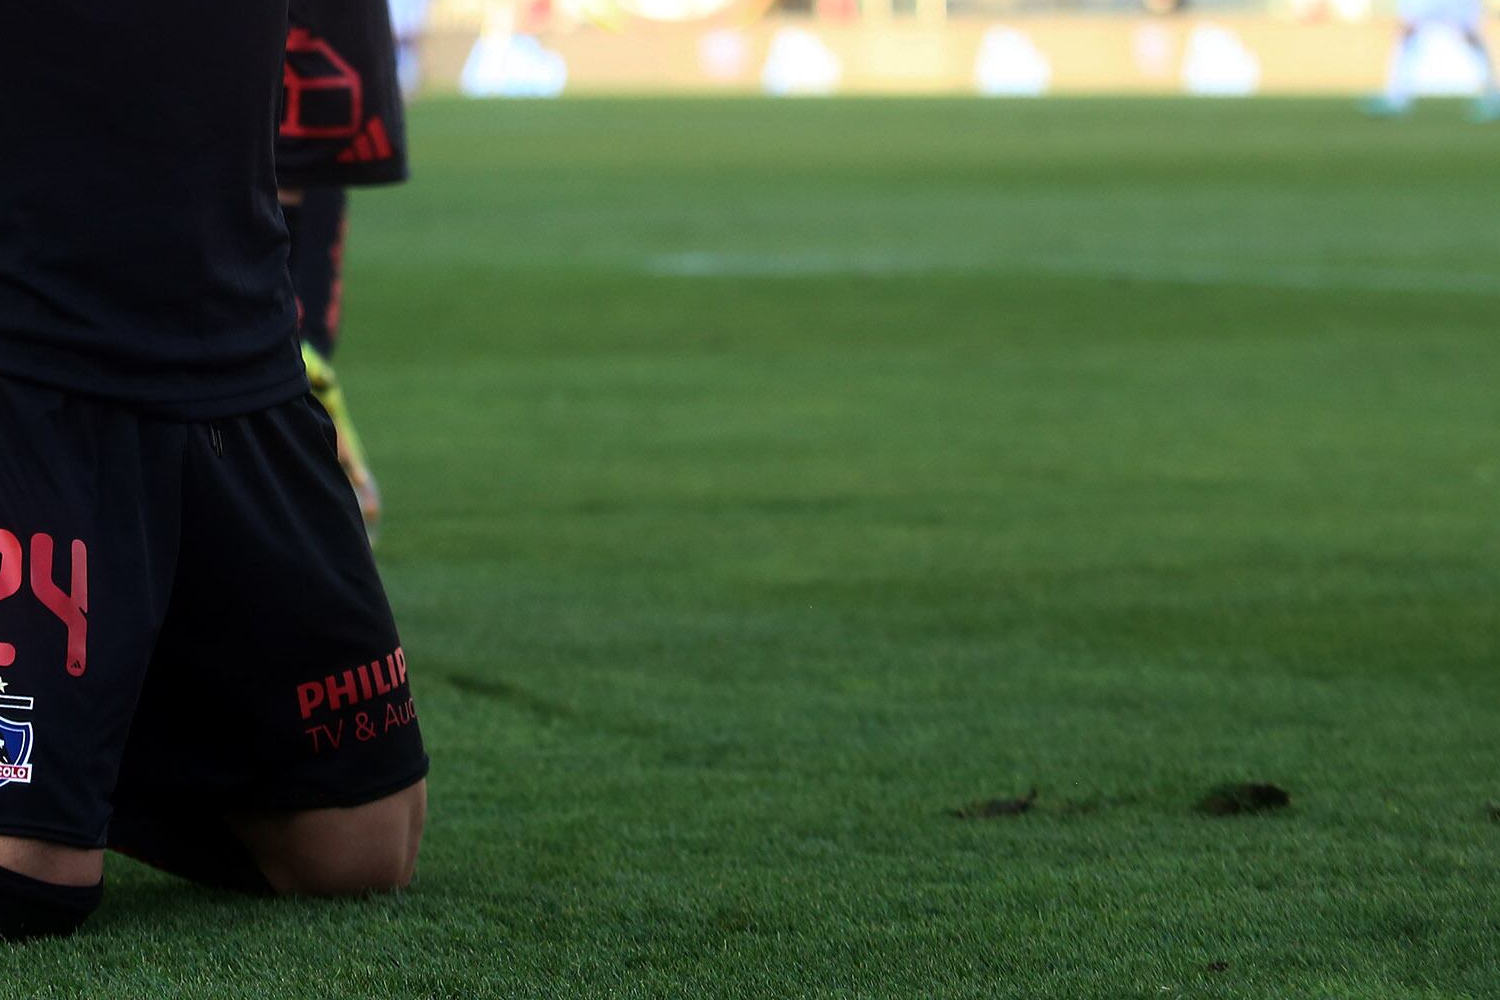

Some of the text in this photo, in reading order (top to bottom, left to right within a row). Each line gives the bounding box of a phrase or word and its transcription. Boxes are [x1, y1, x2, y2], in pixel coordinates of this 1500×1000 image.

[297, 646, 407, 720] PHILIP
[305, 718, 343, 755] TV
[356, 711, 377, 741] &
